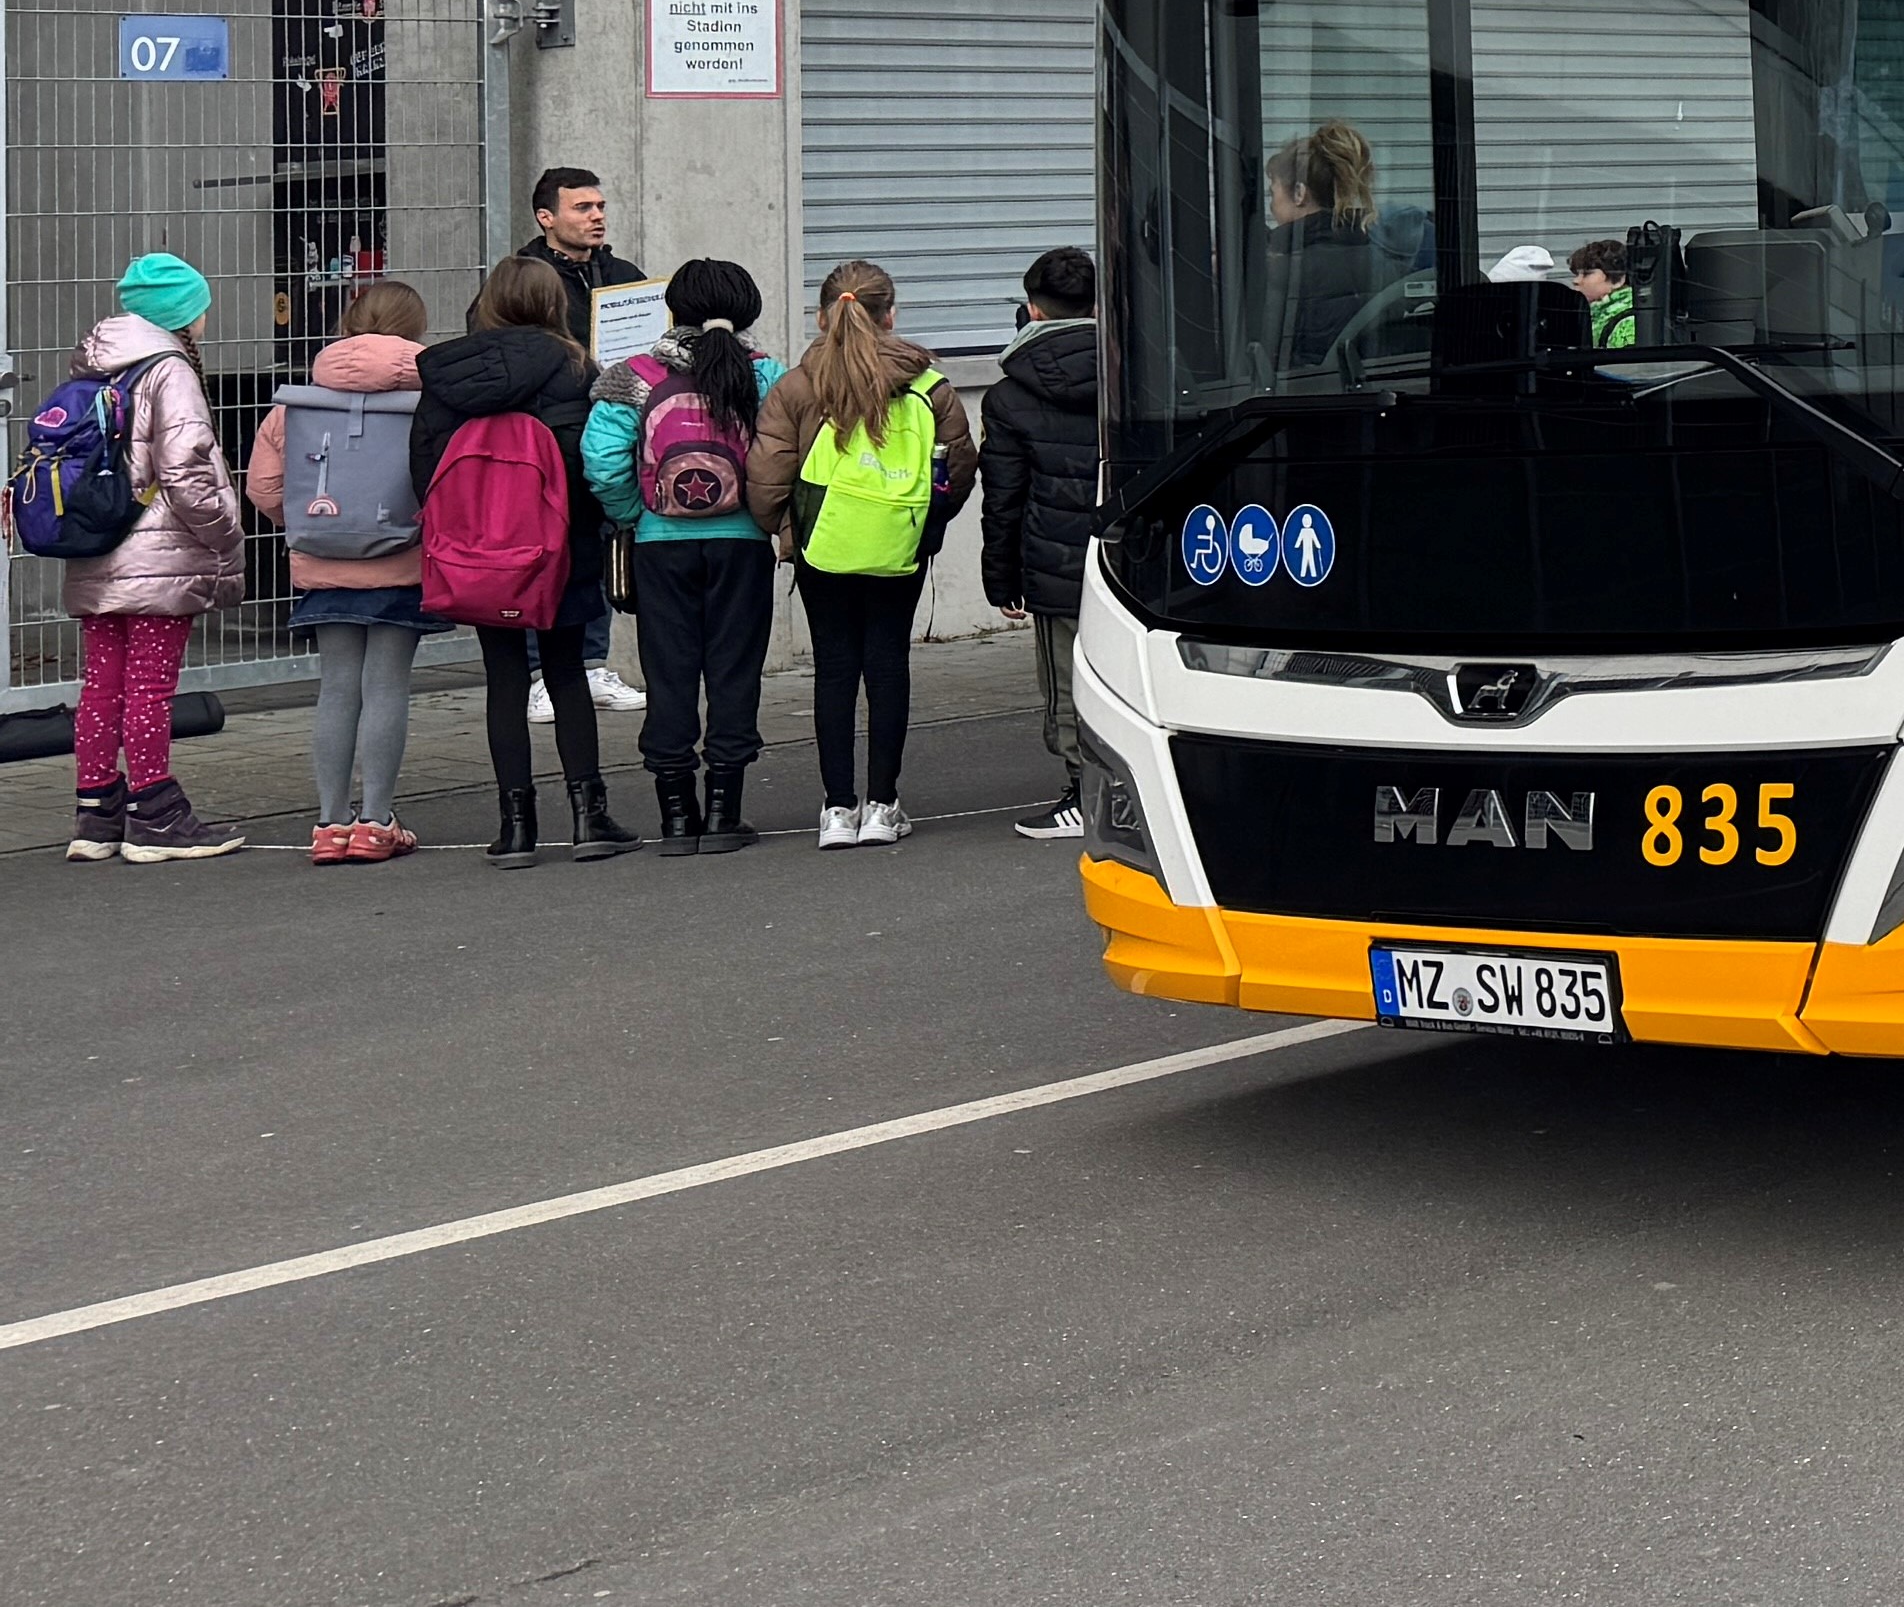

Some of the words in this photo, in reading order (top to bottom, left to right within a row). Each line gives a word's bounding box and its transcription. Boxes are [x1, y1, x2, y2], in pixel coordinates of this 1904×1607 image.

[669, 0, 706, 14] nicht
[711, 2, 733, 14] mit
[737, 2, 758, 14] ins
[687, 19, 742, 33] Stadion
[131, 36, 180, 72] 07
[674, 41, 755, 54] genommen
[686, 57, 743, 70] werden!
[1374, 785, 1596, 851] MAN
[1641, 782, 1798, 867] 835
[1383, 989, 1393, 1004] D
[1396, 958, 1450, 1011] MZ
[1475, 963, 1524, 1017] SW
[1535, 967, 1606, 1022] 835
